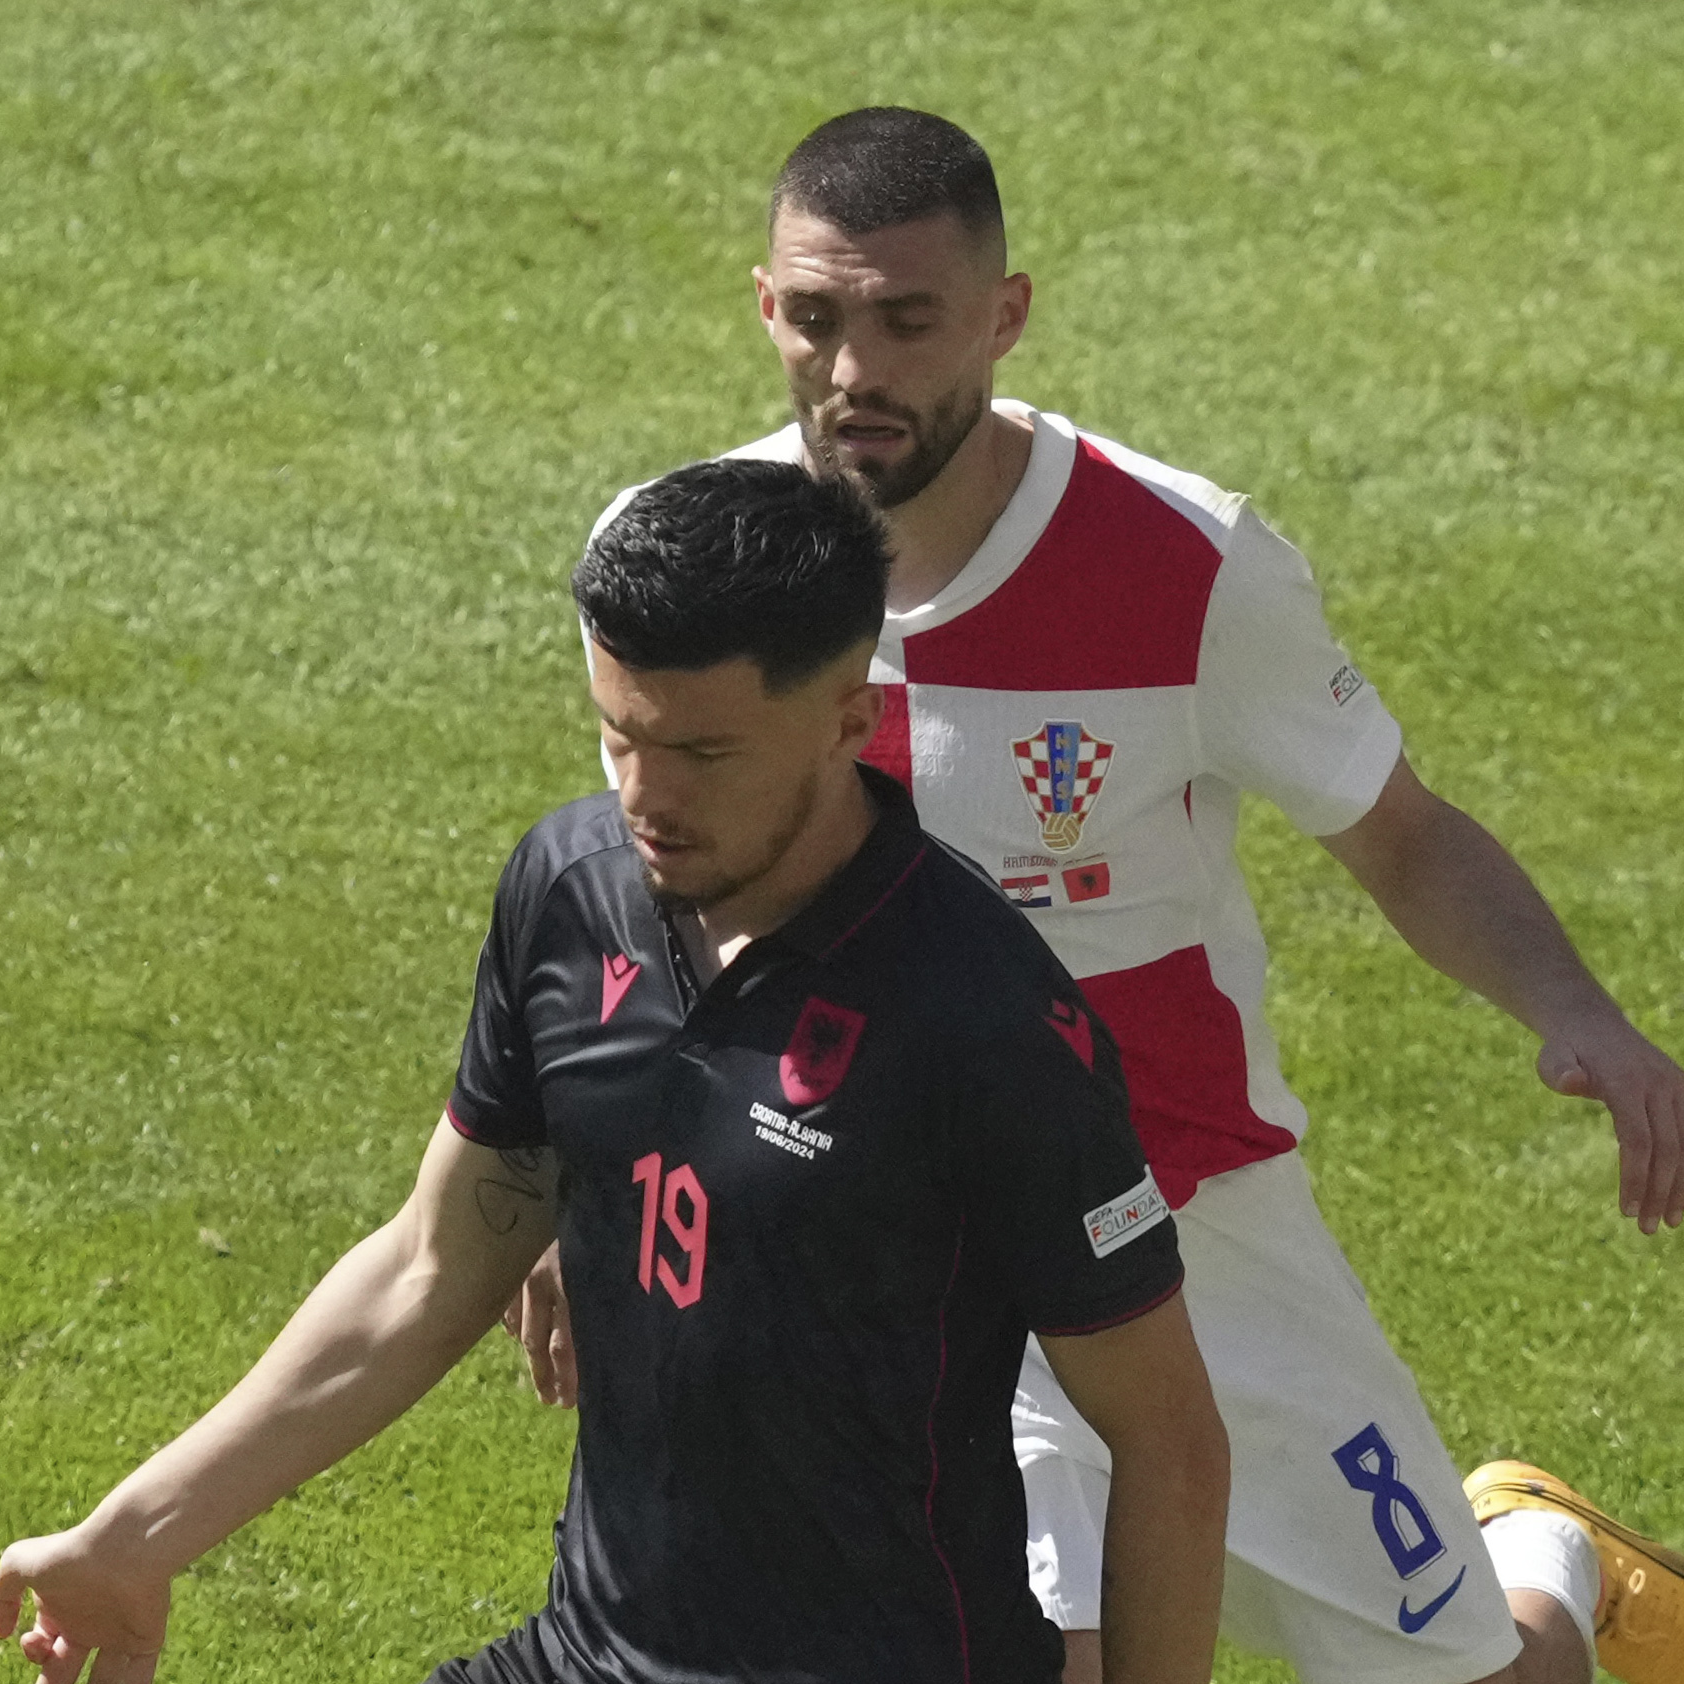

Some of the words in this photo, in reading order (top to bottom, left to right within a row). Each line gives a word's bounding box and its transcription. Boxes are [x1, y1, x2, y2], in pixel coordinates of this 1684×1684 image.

[755, 1125, 815, 1160] 19/06/2024
[632, 1151, 709, 1309] 19
[1331, 1421, 1448, 1581] 8
